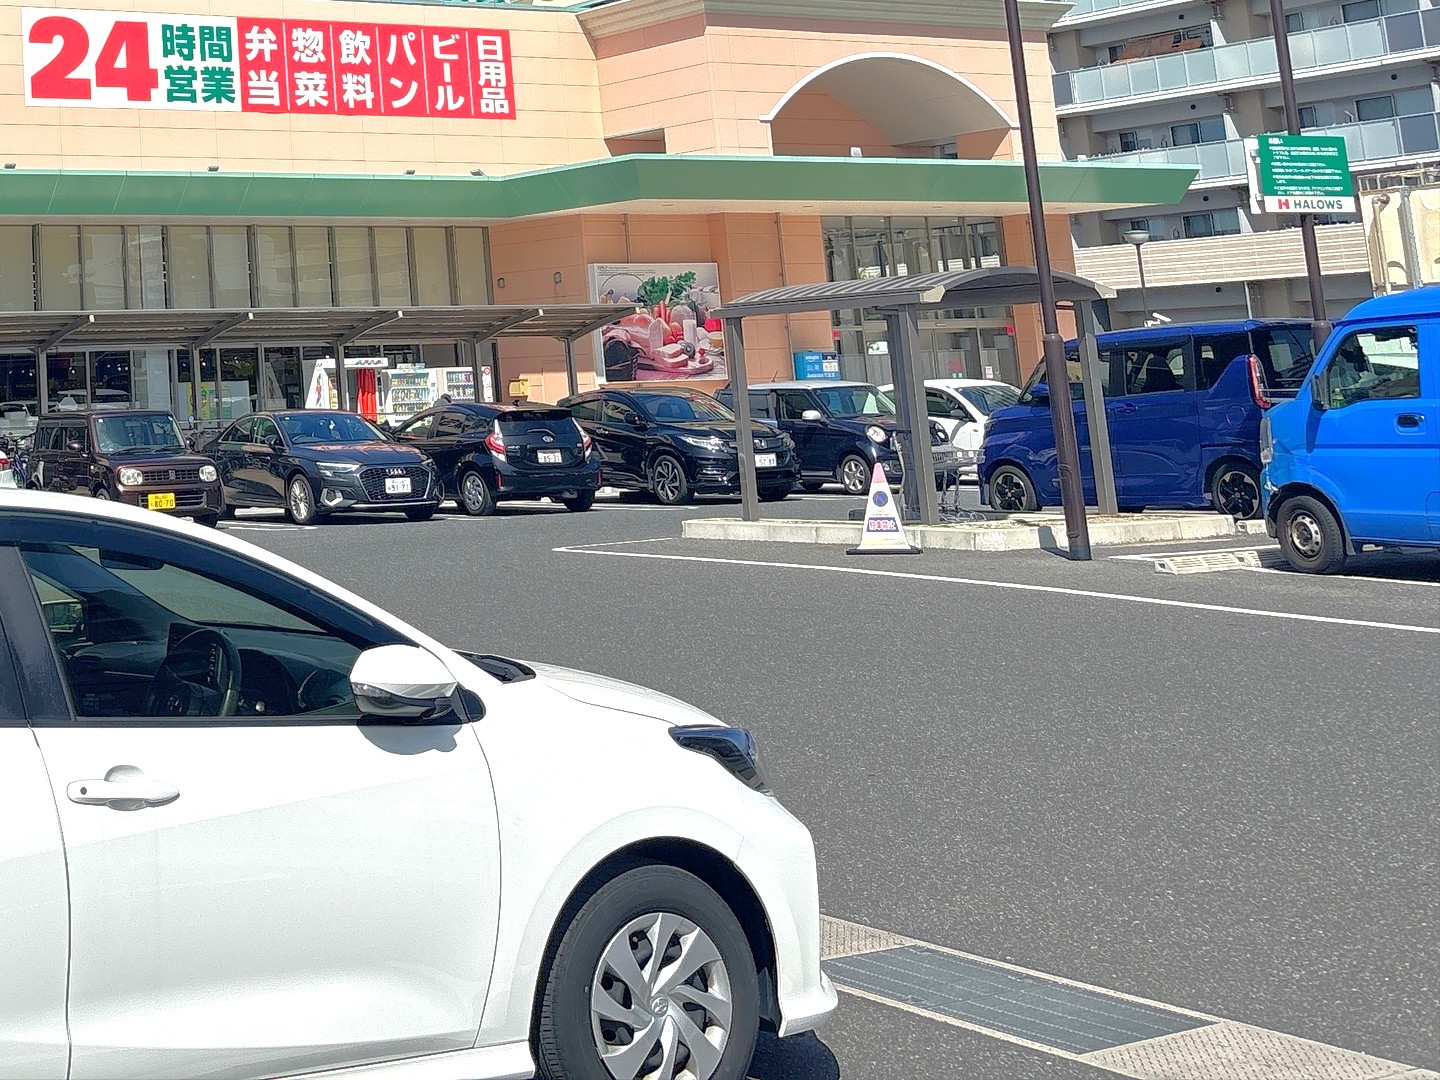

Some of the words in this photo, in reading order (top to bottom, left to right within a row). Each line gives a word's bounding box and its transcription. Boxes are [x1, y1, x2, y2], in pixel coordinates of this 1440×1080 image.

[28, 16, 158, 101] 24
[161, 23, 233, 63] 時間
[245, 25, 280, 107] 弁当
[291, 28, 329, 108] 惣菜
[338, 29, 375, 109] 飲料
[386, 31, 419, 109] パン
[432, 33, 465, 111] ビール
[476, 35, 510, 114] 日用品
[163, 64, 236, 105] 営業
[1293, 200, 1343, 209] HALOWS
